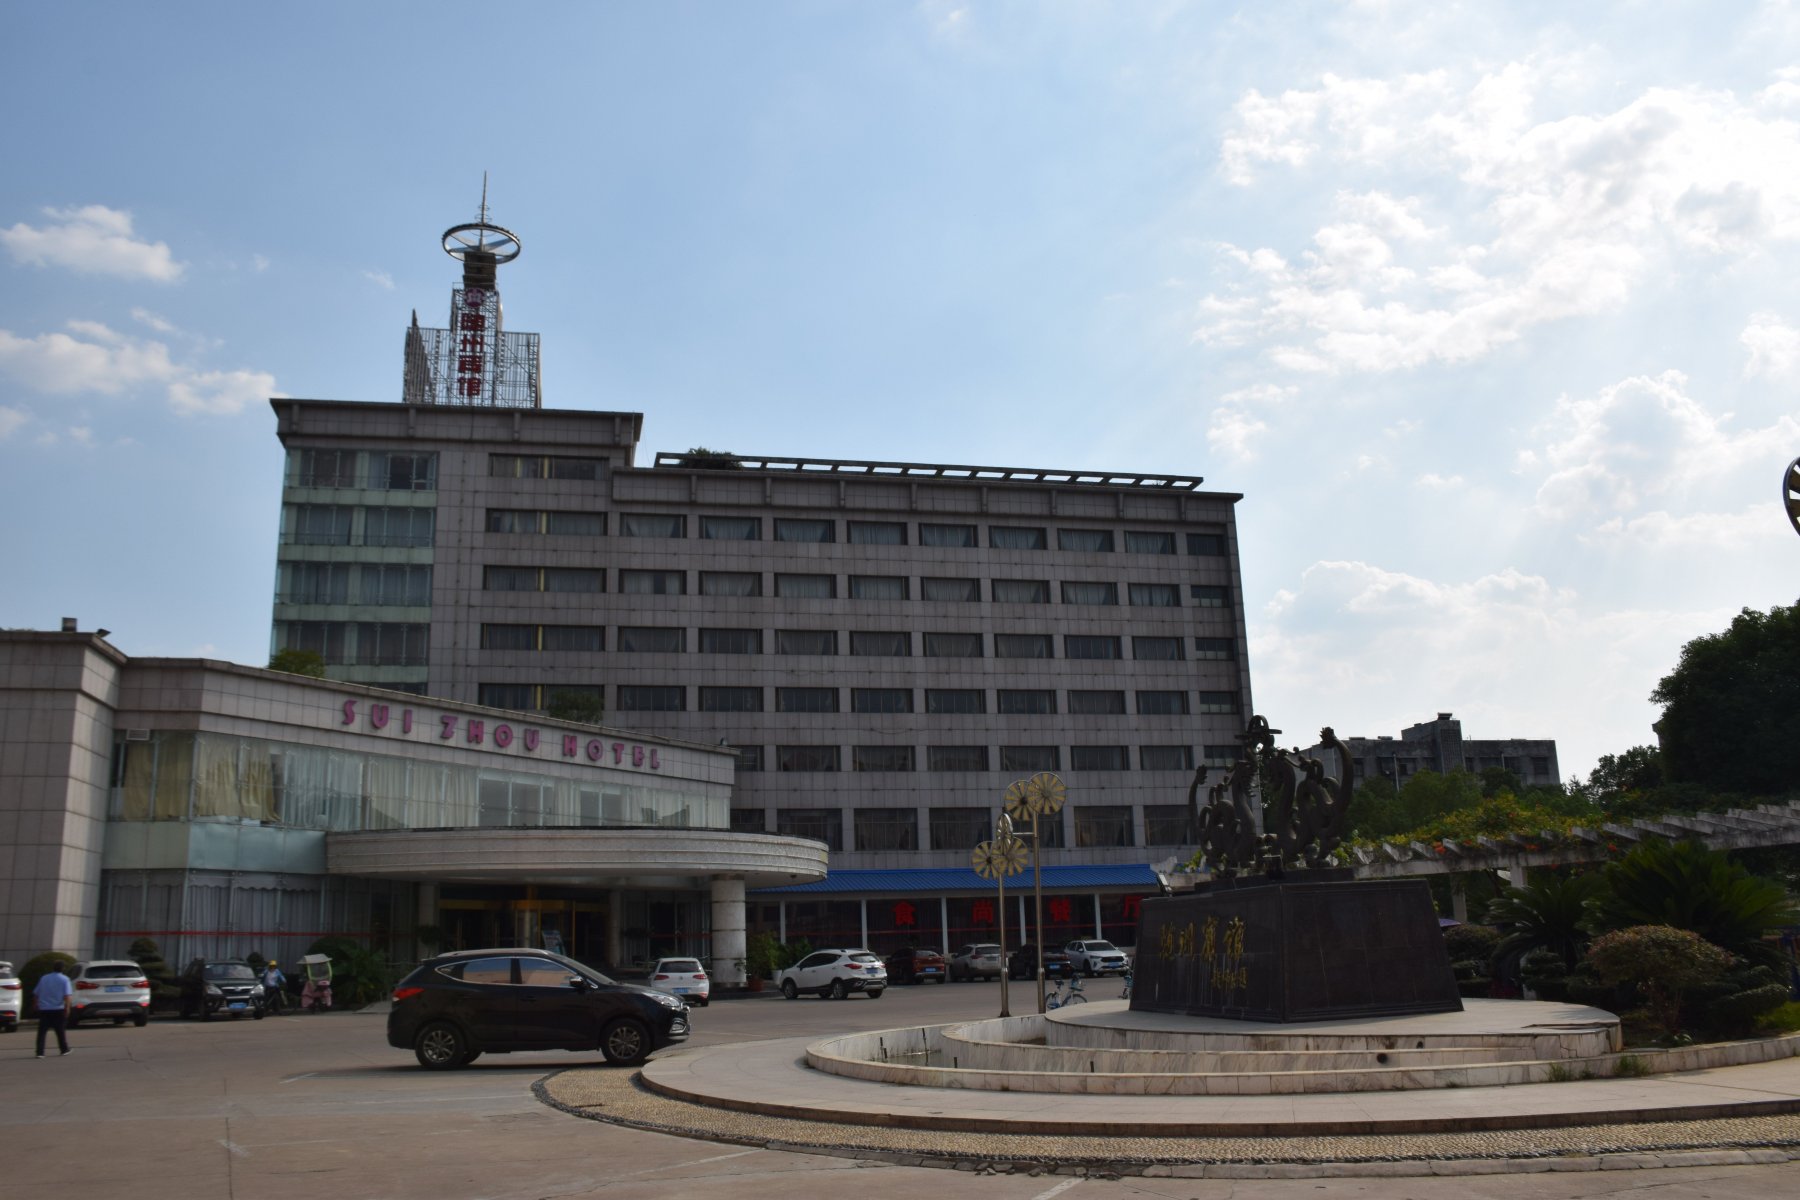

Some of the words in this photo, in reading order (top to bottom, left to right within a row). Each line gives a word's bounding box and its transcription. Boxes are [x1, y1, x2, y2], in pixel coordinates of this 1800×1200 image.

[342, 700, 411, 734] SUI
[440, 715, 539, 751] ZHOU
[563, 735, 661, 770] HOTEL
